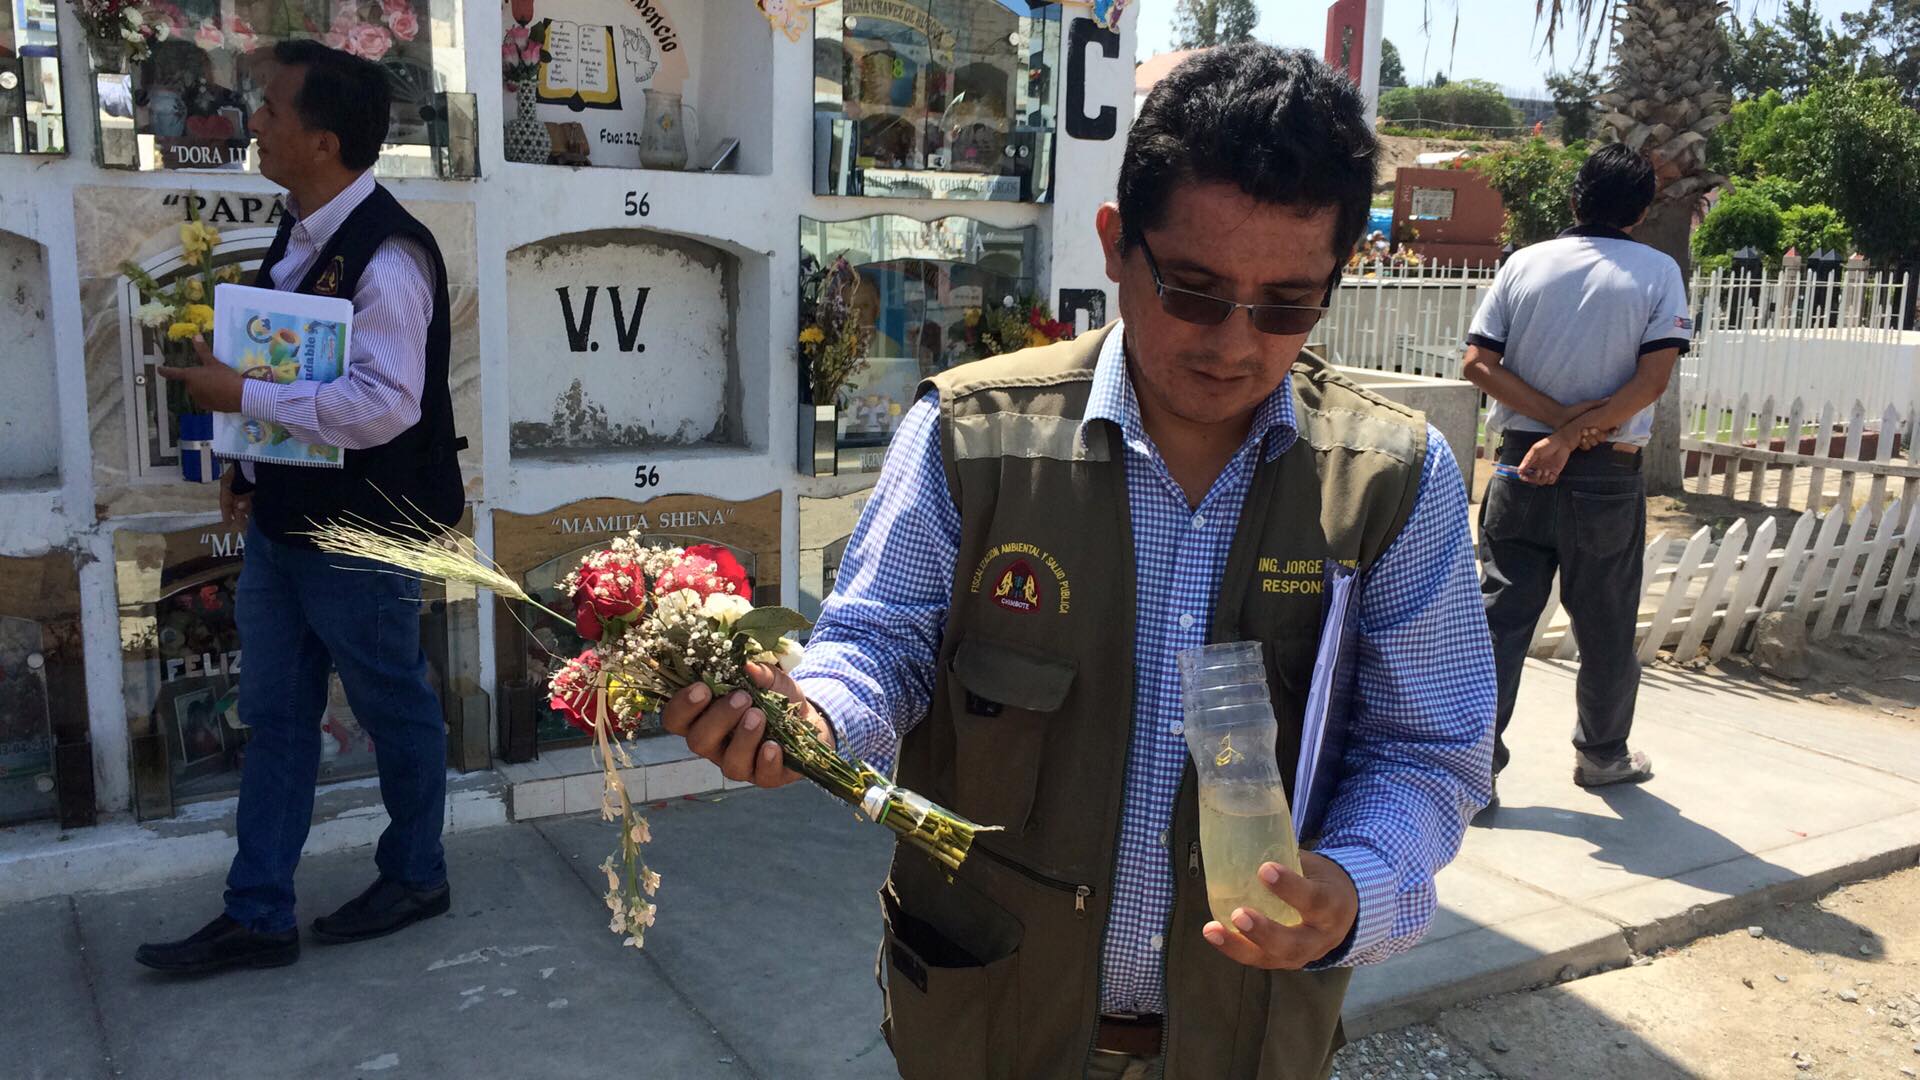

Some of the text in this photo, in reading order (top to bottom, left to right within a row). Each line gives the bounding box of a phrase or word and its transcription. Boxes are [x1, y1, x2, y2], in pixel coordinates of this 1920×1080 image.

[1065, 17, 1120, 140] C
[624, 191, 650, 216] 56
[634, 465, 660, 488] 56
[1001, 542, 1041, 558] AMBIENTAL
[1041, 552, 1049, 561] Y
[1045, 557, 1066, 580] SALUD
[1258, 557, 1280, 573] ING.
[1282, 559, 1324, 574] JORGE
[166, 650, 242, 683] FELIZ
